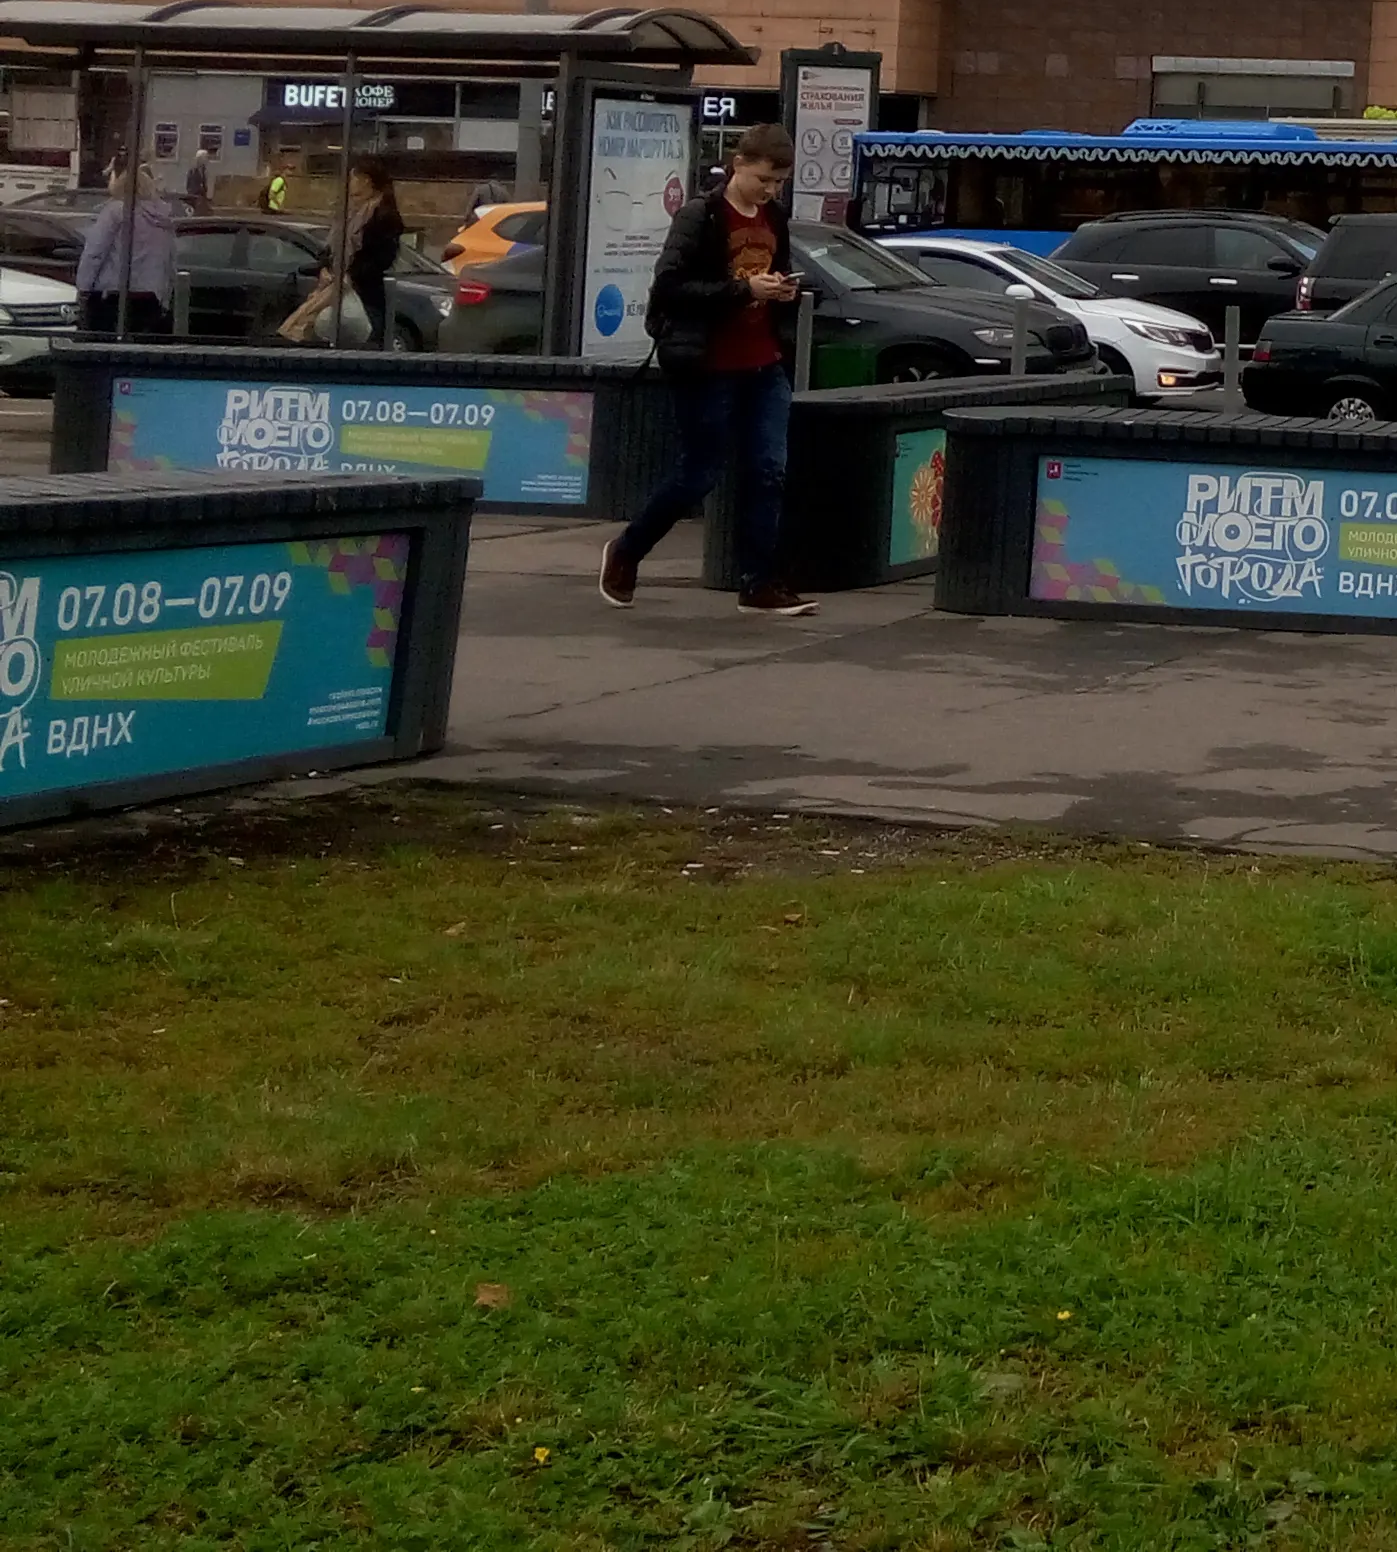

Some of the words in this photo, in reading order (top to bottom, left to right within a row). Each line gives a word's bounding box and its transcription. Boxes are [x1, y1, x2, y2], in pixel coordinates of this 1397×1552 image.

[1187, 473, 1325, 519] РИТМ
[1176, 511, 1329, 553] МОЕГО
[180, 633, 264, 659] ФЕСТИВАЛЬ
[61, 674, 134, 696] УЛИЧНОЙ
[136, 664, 212, 687] КУЛЬТУРЫ
[46, 710, 137, 758] ВДНХ
